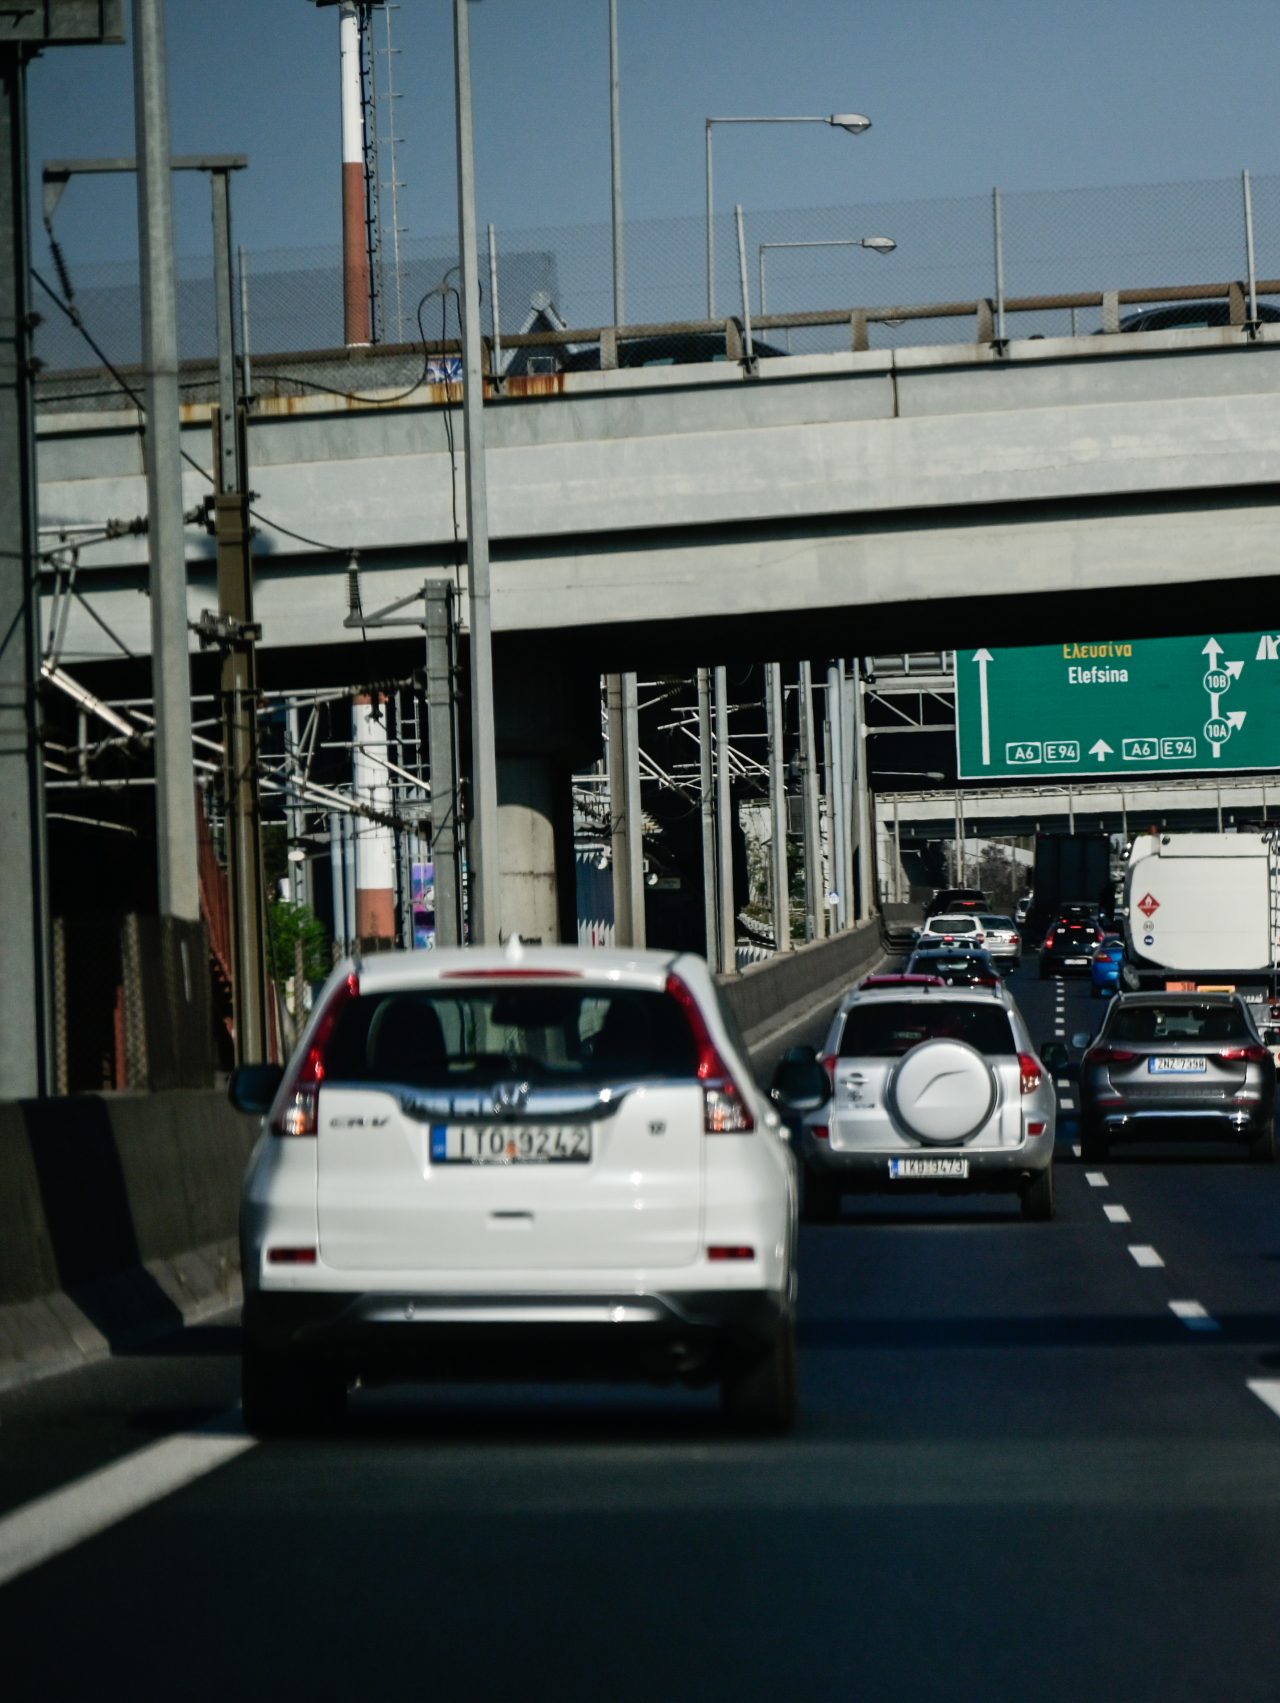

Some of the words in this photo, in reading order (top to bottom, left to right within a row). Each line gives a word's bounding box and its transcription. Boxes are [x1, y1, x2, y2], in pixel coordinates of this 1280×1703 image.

[1062, 641, 1133, 659] Ελευσίνα
[1068, 665, 1129, 684] Elefsina
[1207, 675, 1227, 688] 10B
[1207, 724, 1227, 738] 10A
[1015, 747, 1034, 760] A6
[1047, 745, 1056, 759] E
[1058, 745, 1076, 759] 94
[1132, 743, 1151, 756] A6
[1164, 742, 1173, 756] E
[1175, 742, 1192, 755] 94
